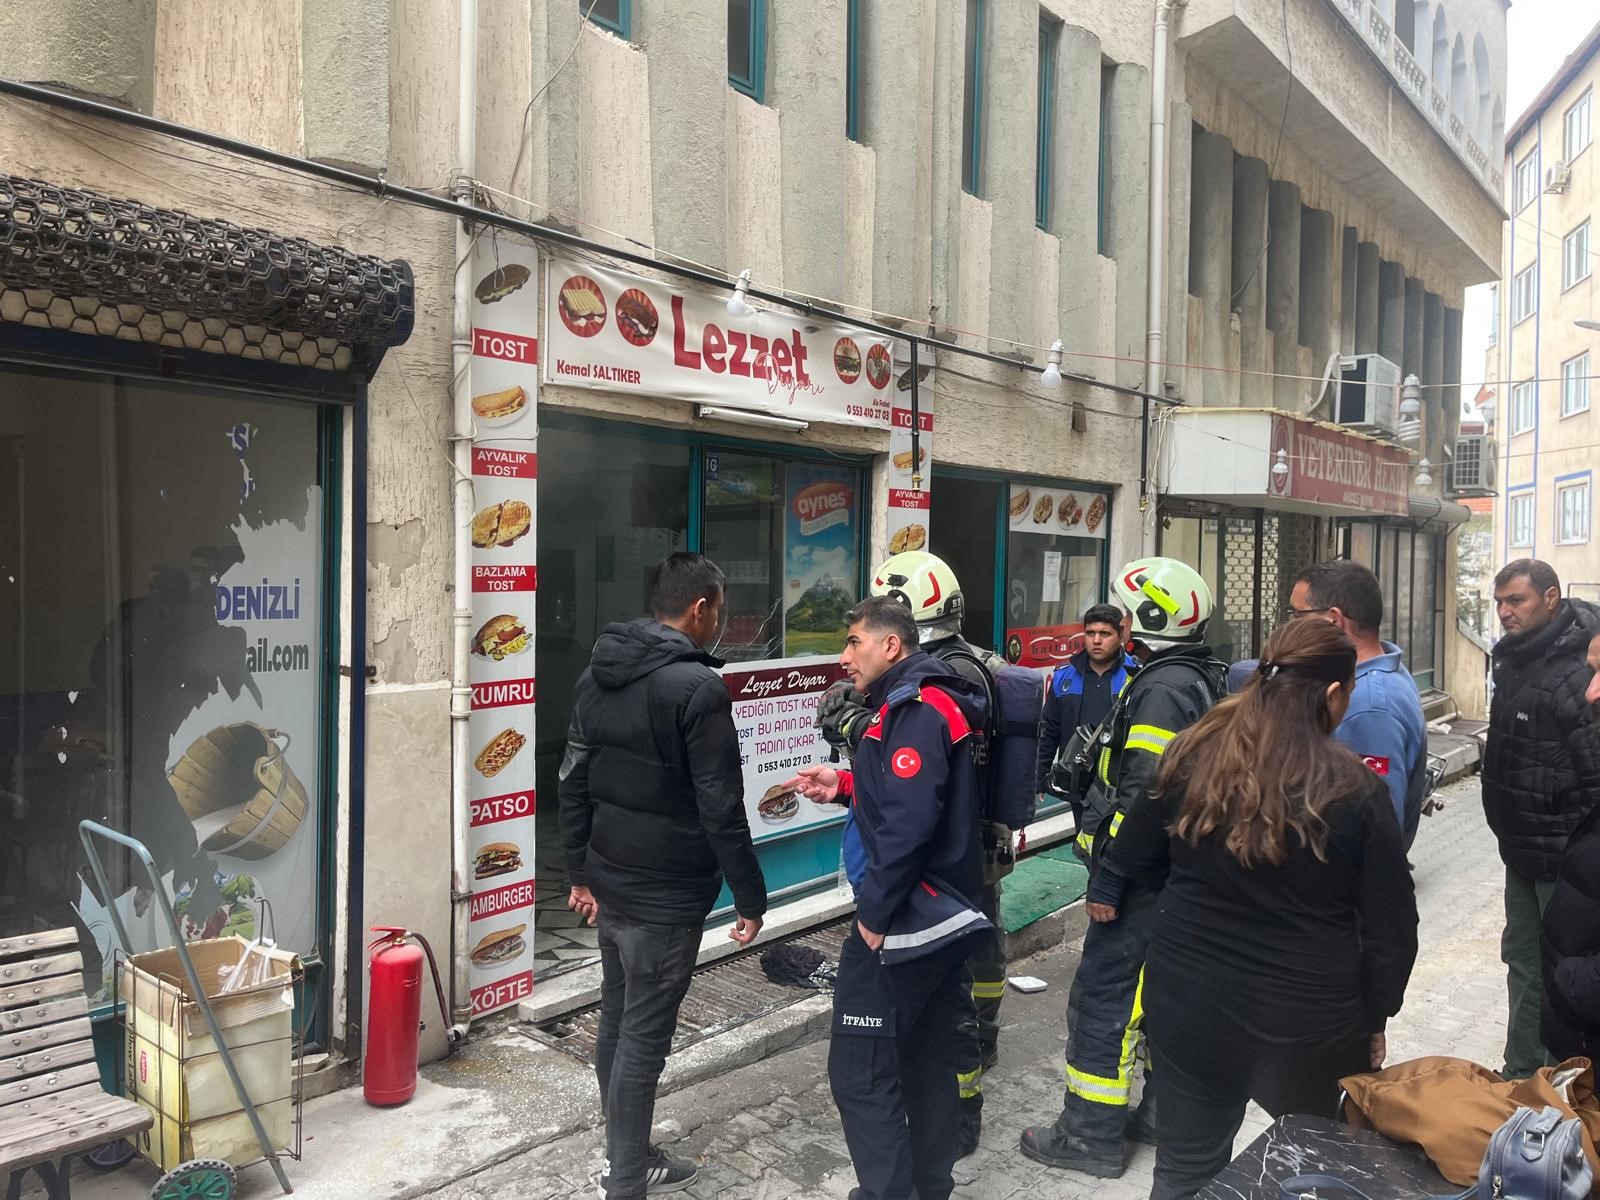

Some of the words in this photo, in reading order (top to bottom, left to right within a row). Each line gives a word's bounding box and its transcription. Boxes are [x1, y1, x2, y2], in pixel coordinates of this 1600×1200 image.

[479, 335, 528, 360] TOST
[671, 294, 809, 383] Lezzet
[557, 359, 591, 378] Kemal
[593, 364, 641, 385] SALTIKER
[852, 405, 863, 417] 553
[864, 407, 874, 418] 410
[874, 409, 882, 419] 27
[882, 410, 890, 421] 03
[898, 412, 927, 429] TOT
[477, 450, 527, 464] AYVALIK
[487, 464, 518, 477] TOST
[798, 491, 846, 518] aynes
[895, 491, 925, 500] AYVALIK
[900, 500, 919, 508] TOST
[475, 566, 527, 577] BAZLAMA
[487, 580, 516, 591] TOST
[216, 577, 300, 621] DENİZLİ
[470, 682, 534, 706] KUMRU
[741, 675, 783, 696] Lezzet
[776, 699, 800, 713] TOST
[758, 722, 772, 735] BU
[774, 718, 797, 731] ANIN
[799, 716, 812, 728] DA
[755, 739, 785, 756] TADINI
[787, 734, 815, 754] ÇIKAR
[758, 764, 763, 773] 0
[764, 761, 778, 772] 553
[779, 758, 791, 770] 410
[793, 757, 802, 768] 27
[802, 755, 812, 764] 03
[470, 795, 529, 823] PATSO
[470, 977, 529, 1012] KÖFTE
[842, 1013, 883, 1027] İTFAİYE
